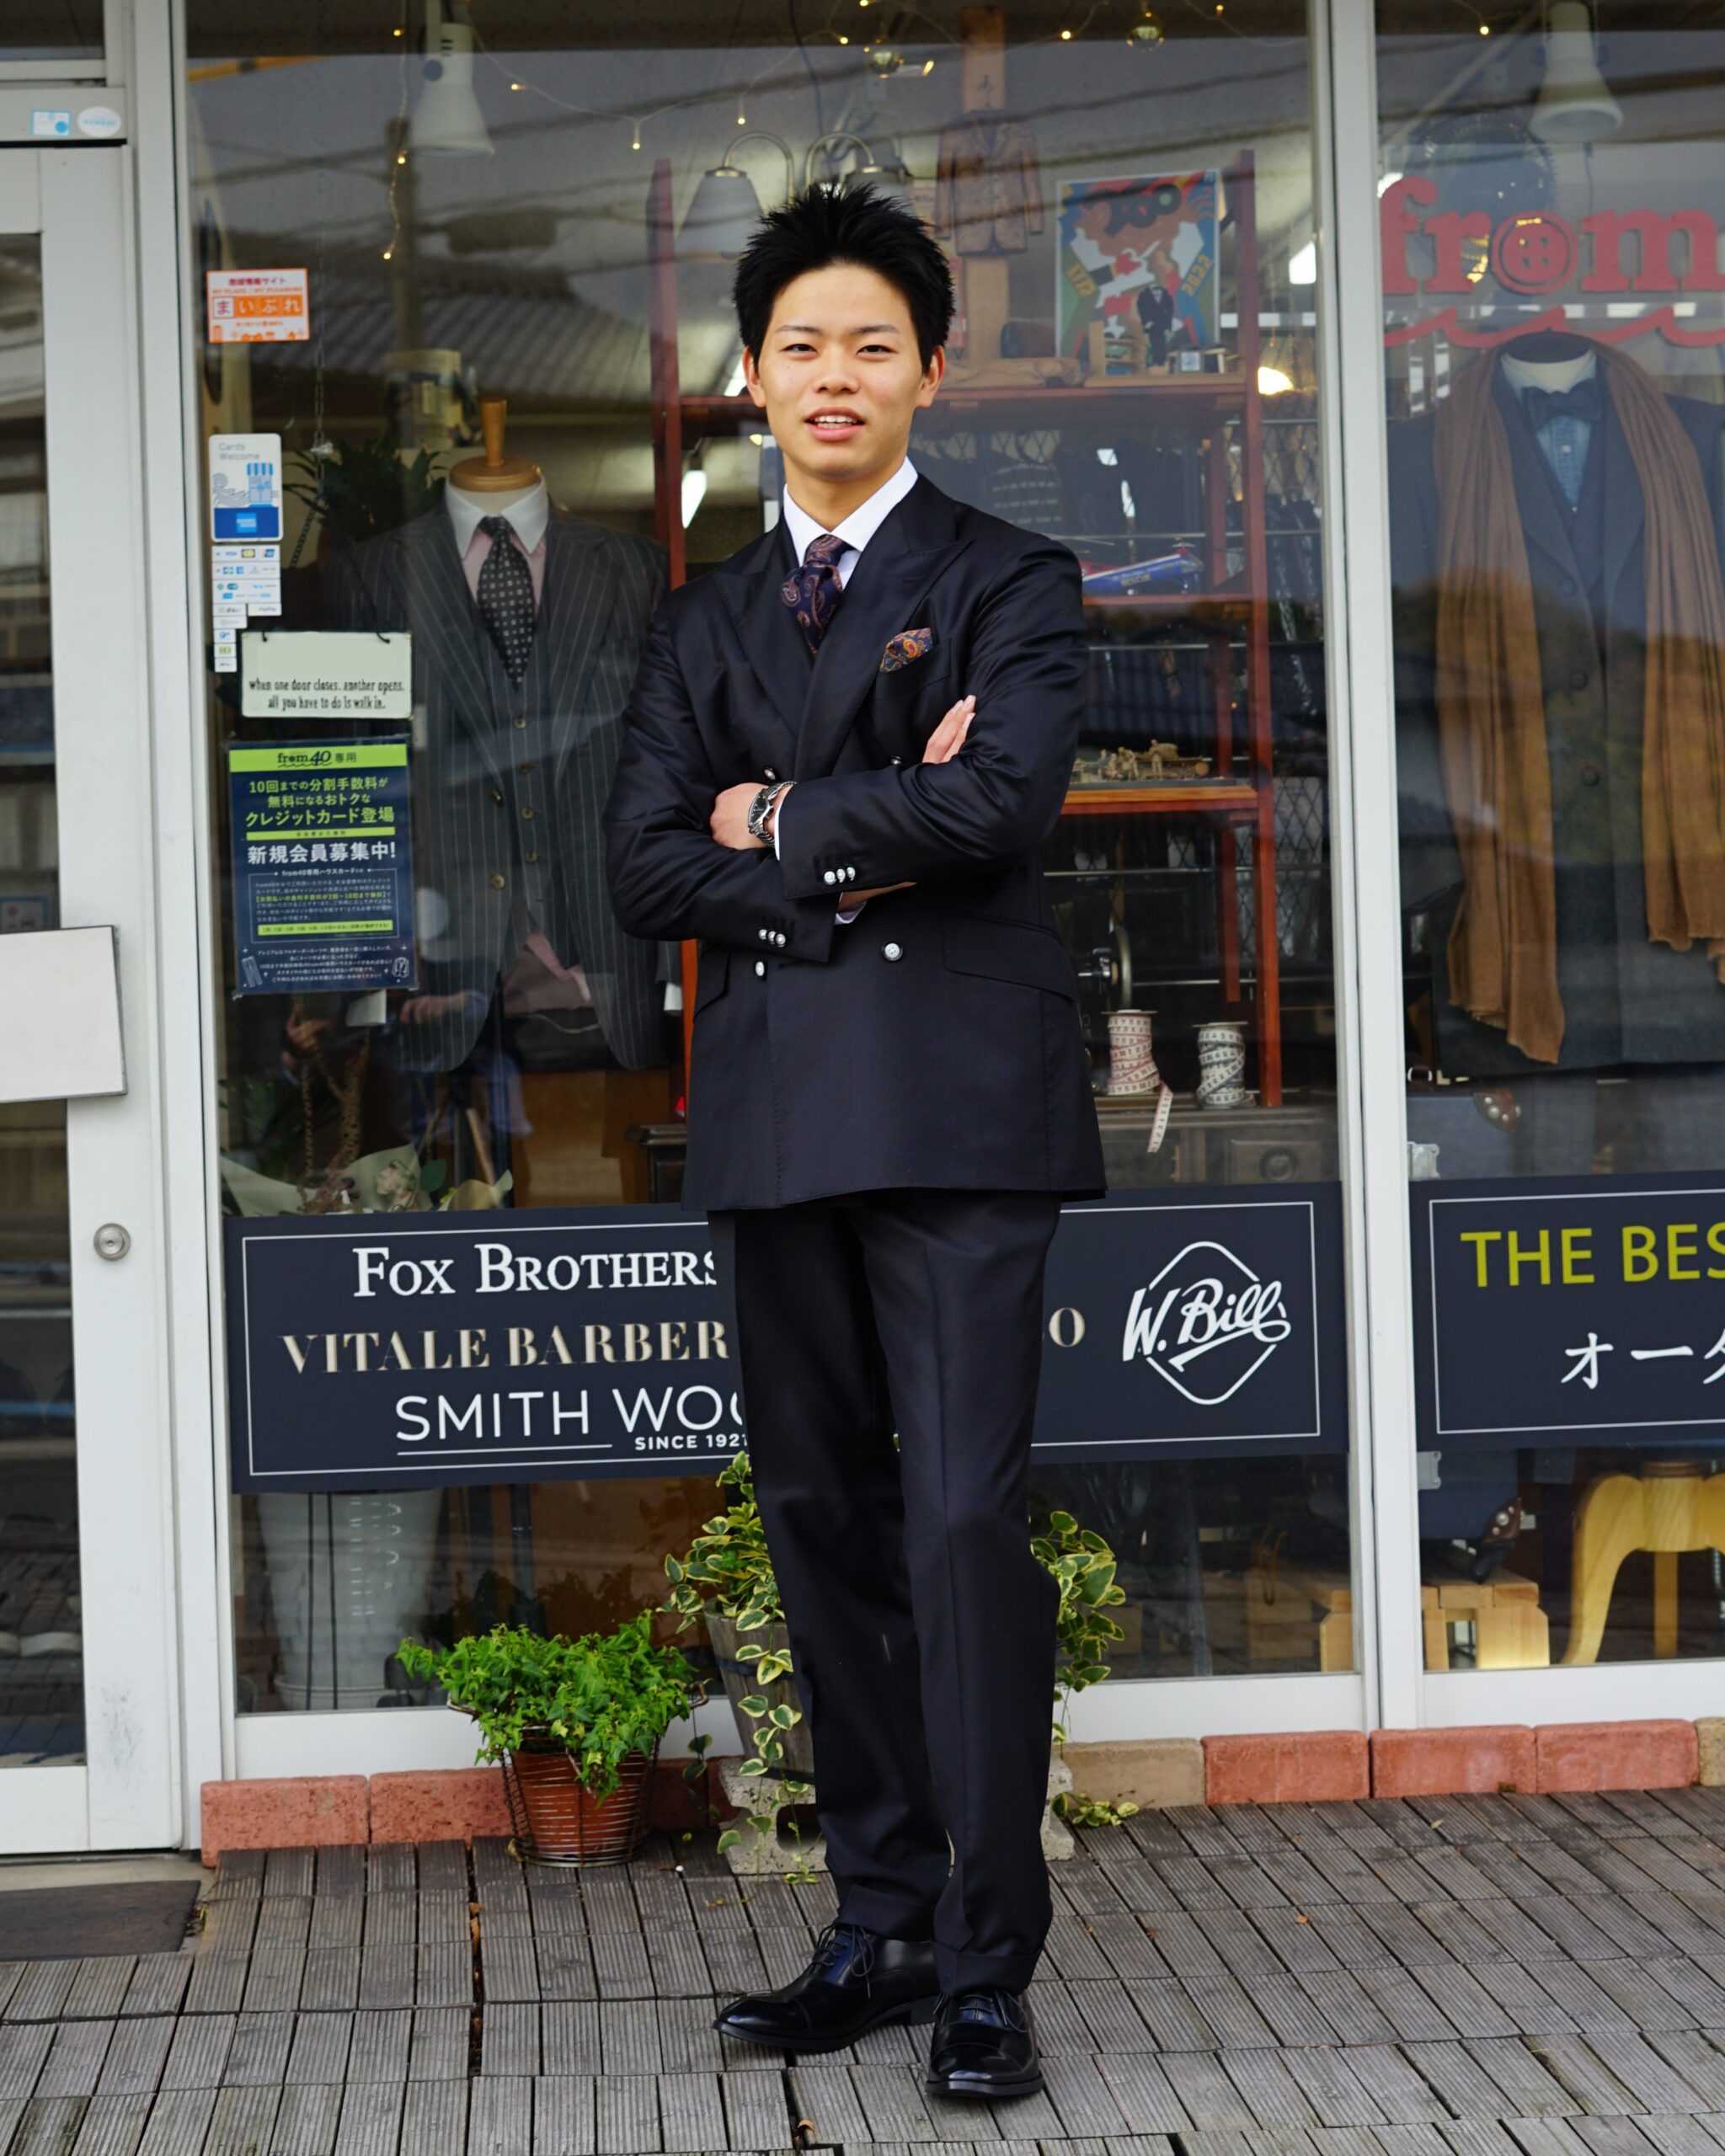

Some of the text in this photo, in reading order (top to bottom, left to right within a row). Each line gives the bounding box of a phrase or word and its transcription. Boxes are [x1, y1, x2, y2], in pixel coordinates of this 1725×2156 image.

[249, 677, 272, 691] when
[275, 680, 289, 691] one
[291, 678, 311, 691] door
[344, 679, 375, 691] another
[268, 696, 279, 708] all
[282, 699, 296, 711] you
[299, 696, 318, 708] have
[321, 697, 328, 708] to
[331, 696, 341, 708] do
[344, 696, 351, 708] is
[354, 696, 371, 708] walk
[277, 750, 332, 766] from40
[249, 776, 388, 793] 10回までの分割手数料が
[268, 793, 371, 808] 無料になるおトクな
[245, 806, 394, 827] クレジットカード登場
[248, 841, 395, 865] 新規会員募集中!
[1461, 1228, 1594, 1287] THE
[1178, 1278, 1291, 1348] Bill
[277, 1329, 490, 1374] VITALE
[396, 1385, 743, 1441] SMITH WO
[635, 1435, 697, 1450] SINCE
